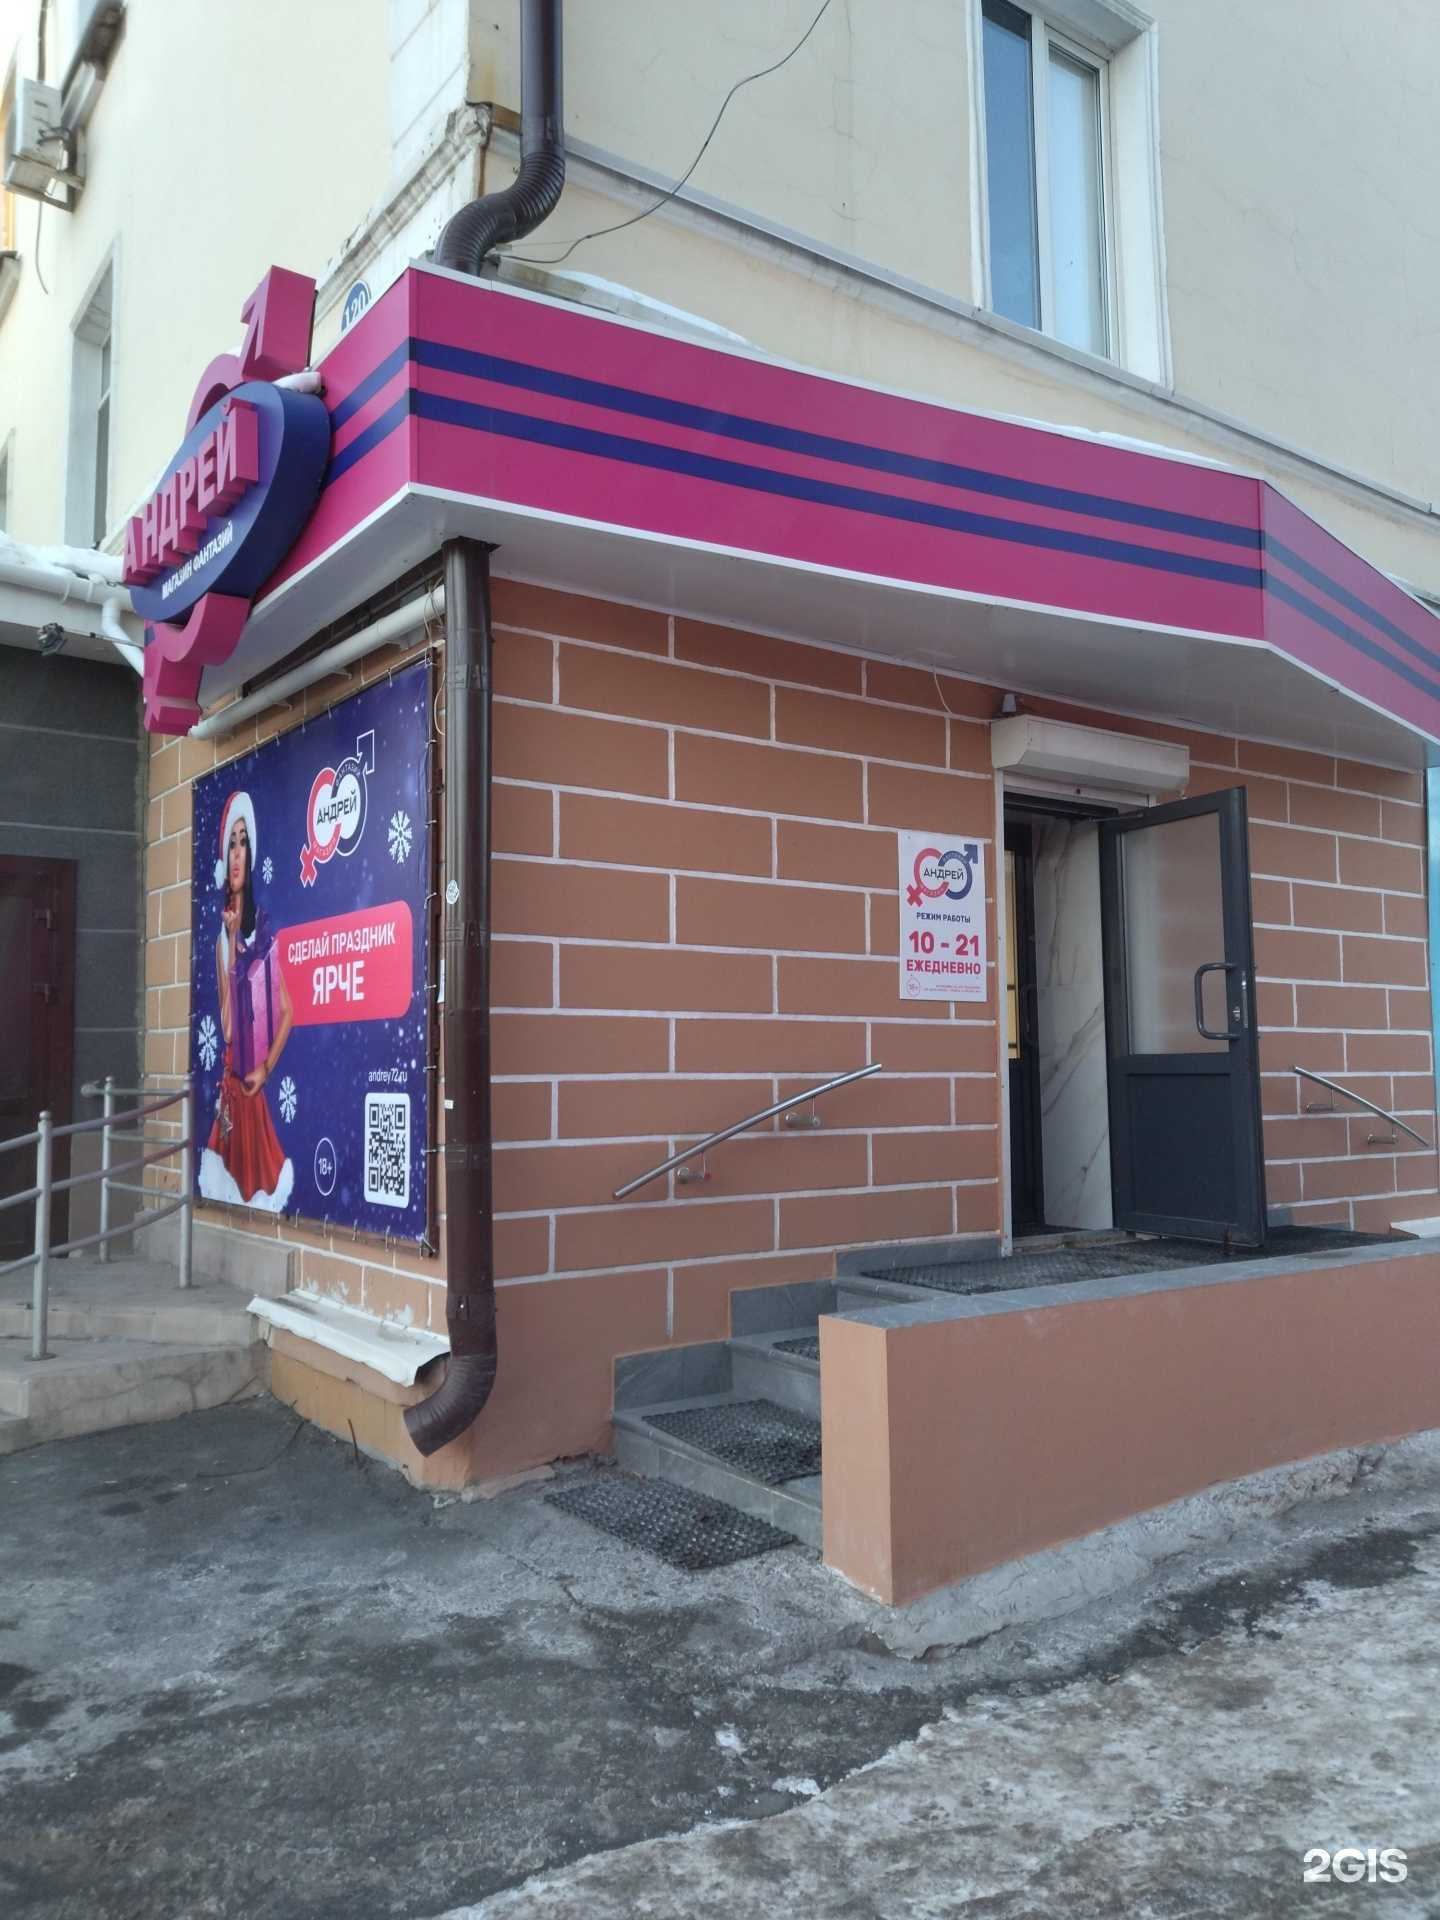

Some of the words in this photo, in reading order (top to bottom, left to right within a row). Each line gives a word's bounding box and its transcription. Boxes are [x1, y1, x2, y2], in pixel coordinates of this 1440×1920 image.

[345, 290, 366, 329] 120
[122, 397, 258, 585] АНДРЕЙ
[162, 560, 192, 600] МАГАЗИН
[193, 520, 233, 572] ФАНТАЗИЙ
[317, 789, 358, 825] АНДРЕЙ
[923, 868, 964, 881] АНДРЕЙ
[916, 912, 941, 920] РЕЖИМ
[943, 914, 971, 923] РАБОТЫ
[288, 931, 330, 965] СДЕЛАЙ
[332, 922, 396, 954] ПРАЗДНИК
[909, 931, 934, 954] 10
[956, 934, 979, 957] 21
[906, 959, 981, 975] ЕЖЕДНЕВНО
[312, 960, 365, 1006] ЯРЧЕ
[368, 1068, 408, 1084] andrey72.ru
[318, 1158, 333, 1176] 18+
